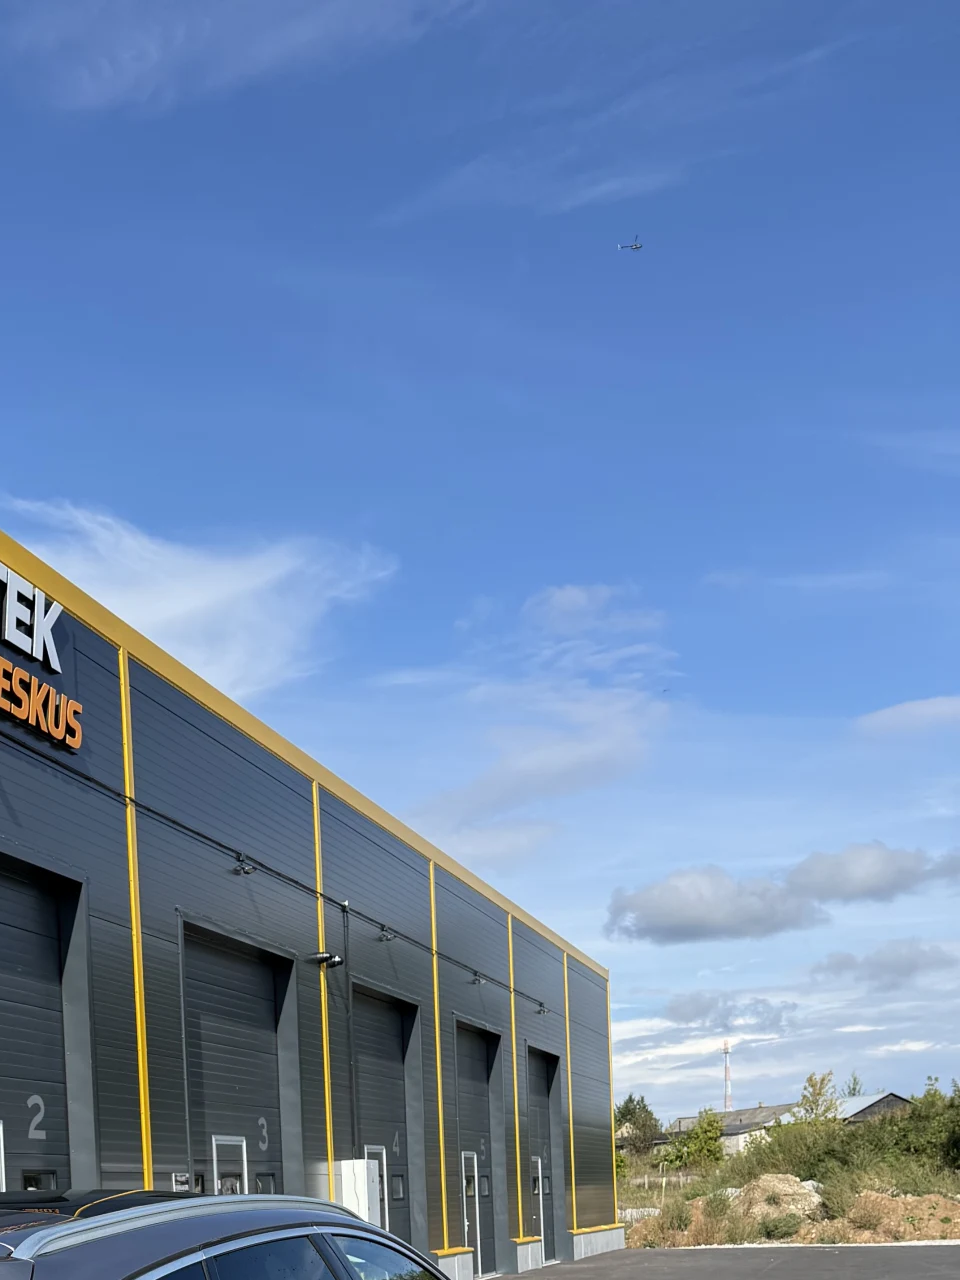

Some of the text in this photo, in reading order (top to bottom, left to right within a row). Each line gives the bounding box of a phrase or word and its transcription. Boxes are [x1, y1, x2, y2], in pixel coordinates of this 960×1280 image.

[26, 1094, 47, 1140] 2
[257, 1116, 270, 1151] 3
[392, 1130, 400, 1157] 4
[480, 1138, 486, 1161] 5
